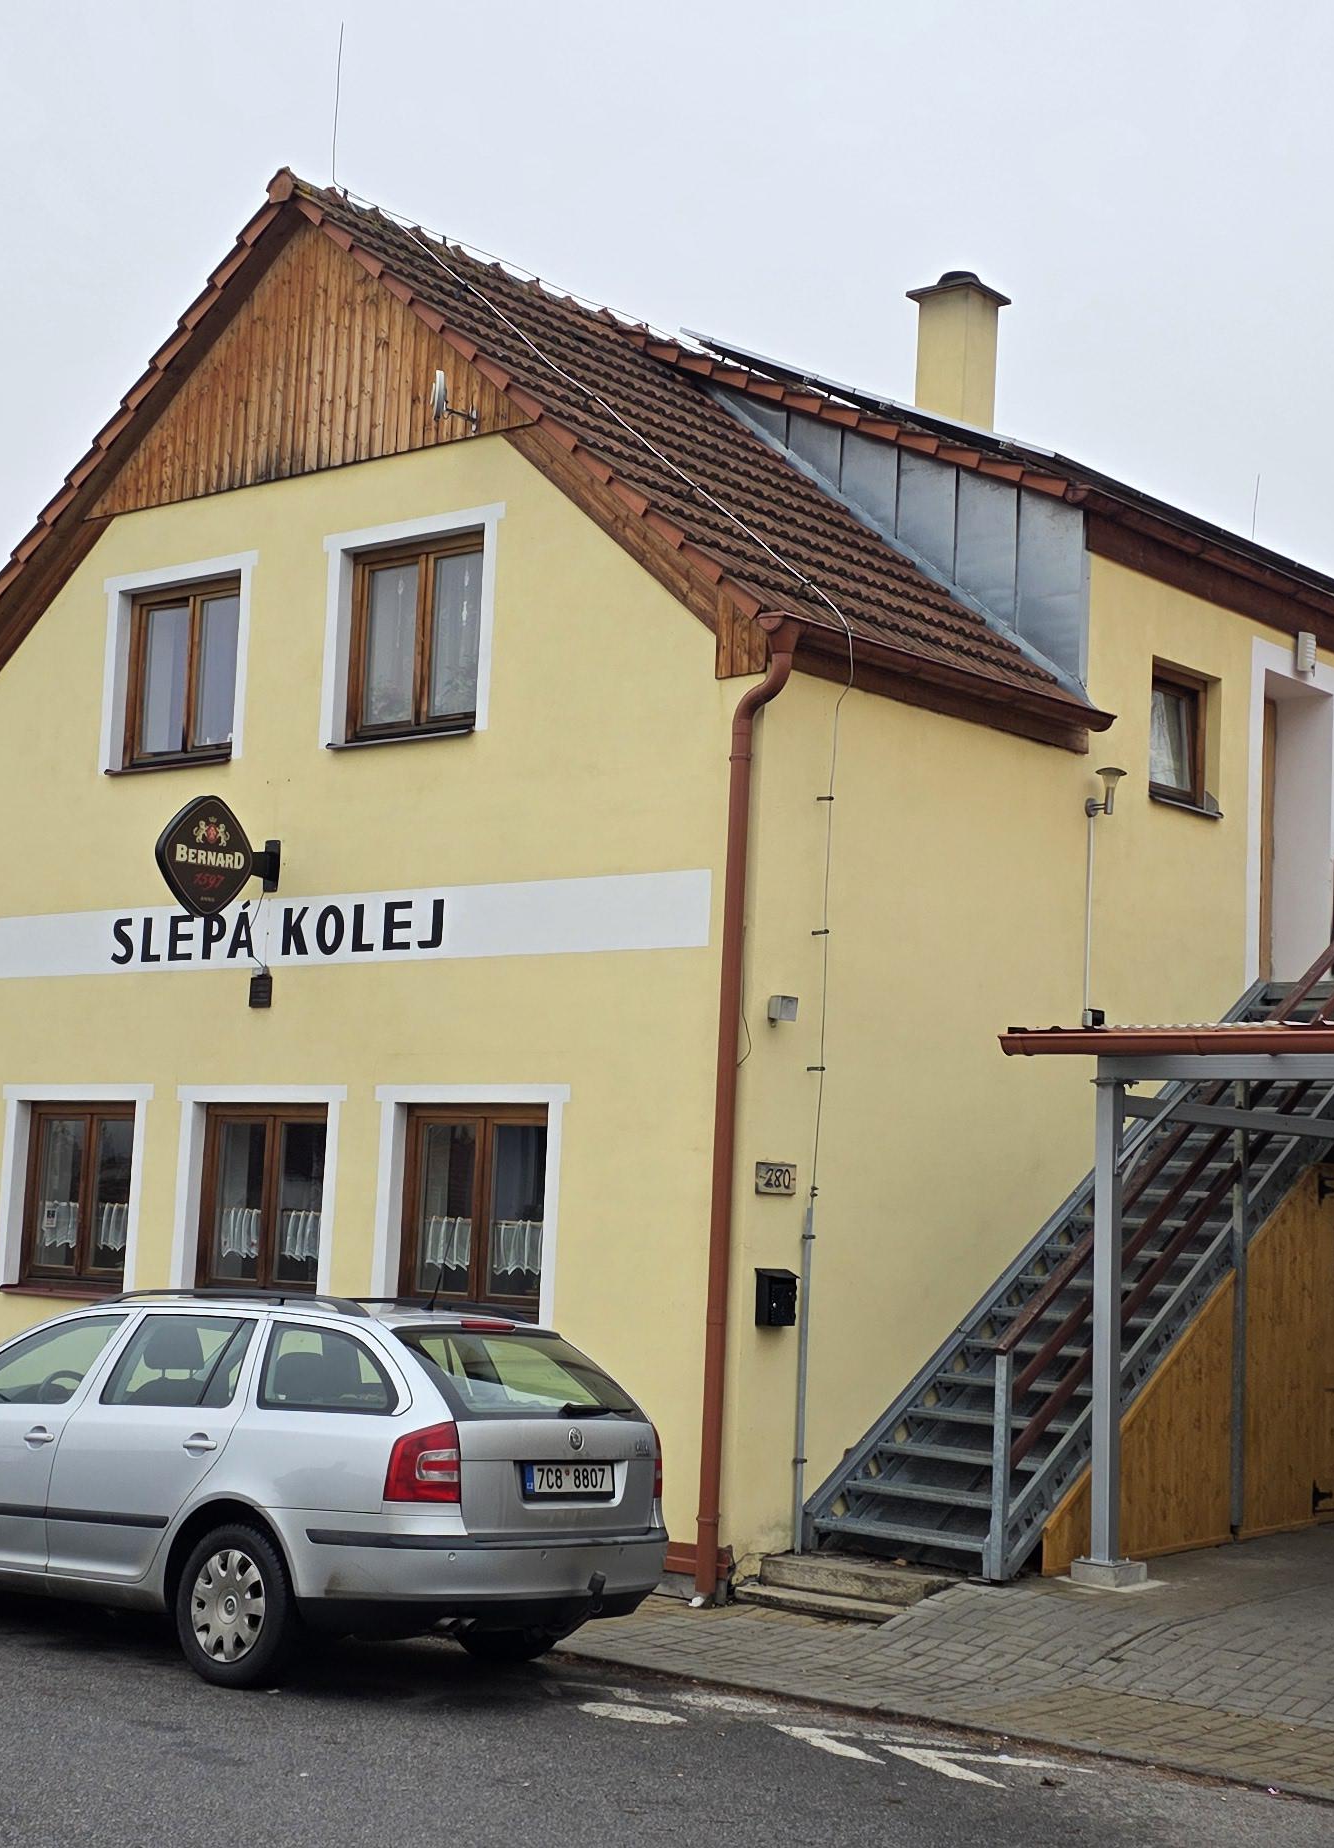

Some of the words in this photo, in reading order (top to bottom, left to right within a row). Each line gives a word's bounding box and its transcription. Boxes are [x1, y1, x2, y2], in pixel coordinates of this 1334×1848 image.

[175, 843, 245, 870] BERNARD
[193, 872, 225, 890] 1597
[111, 900, 254, 965] SLEPÁ
[281, 898, 445, 956] KOLEJ
[537, 1467, 563, 1490] 7C8
[573, 1467, 606, 1489] 8807
